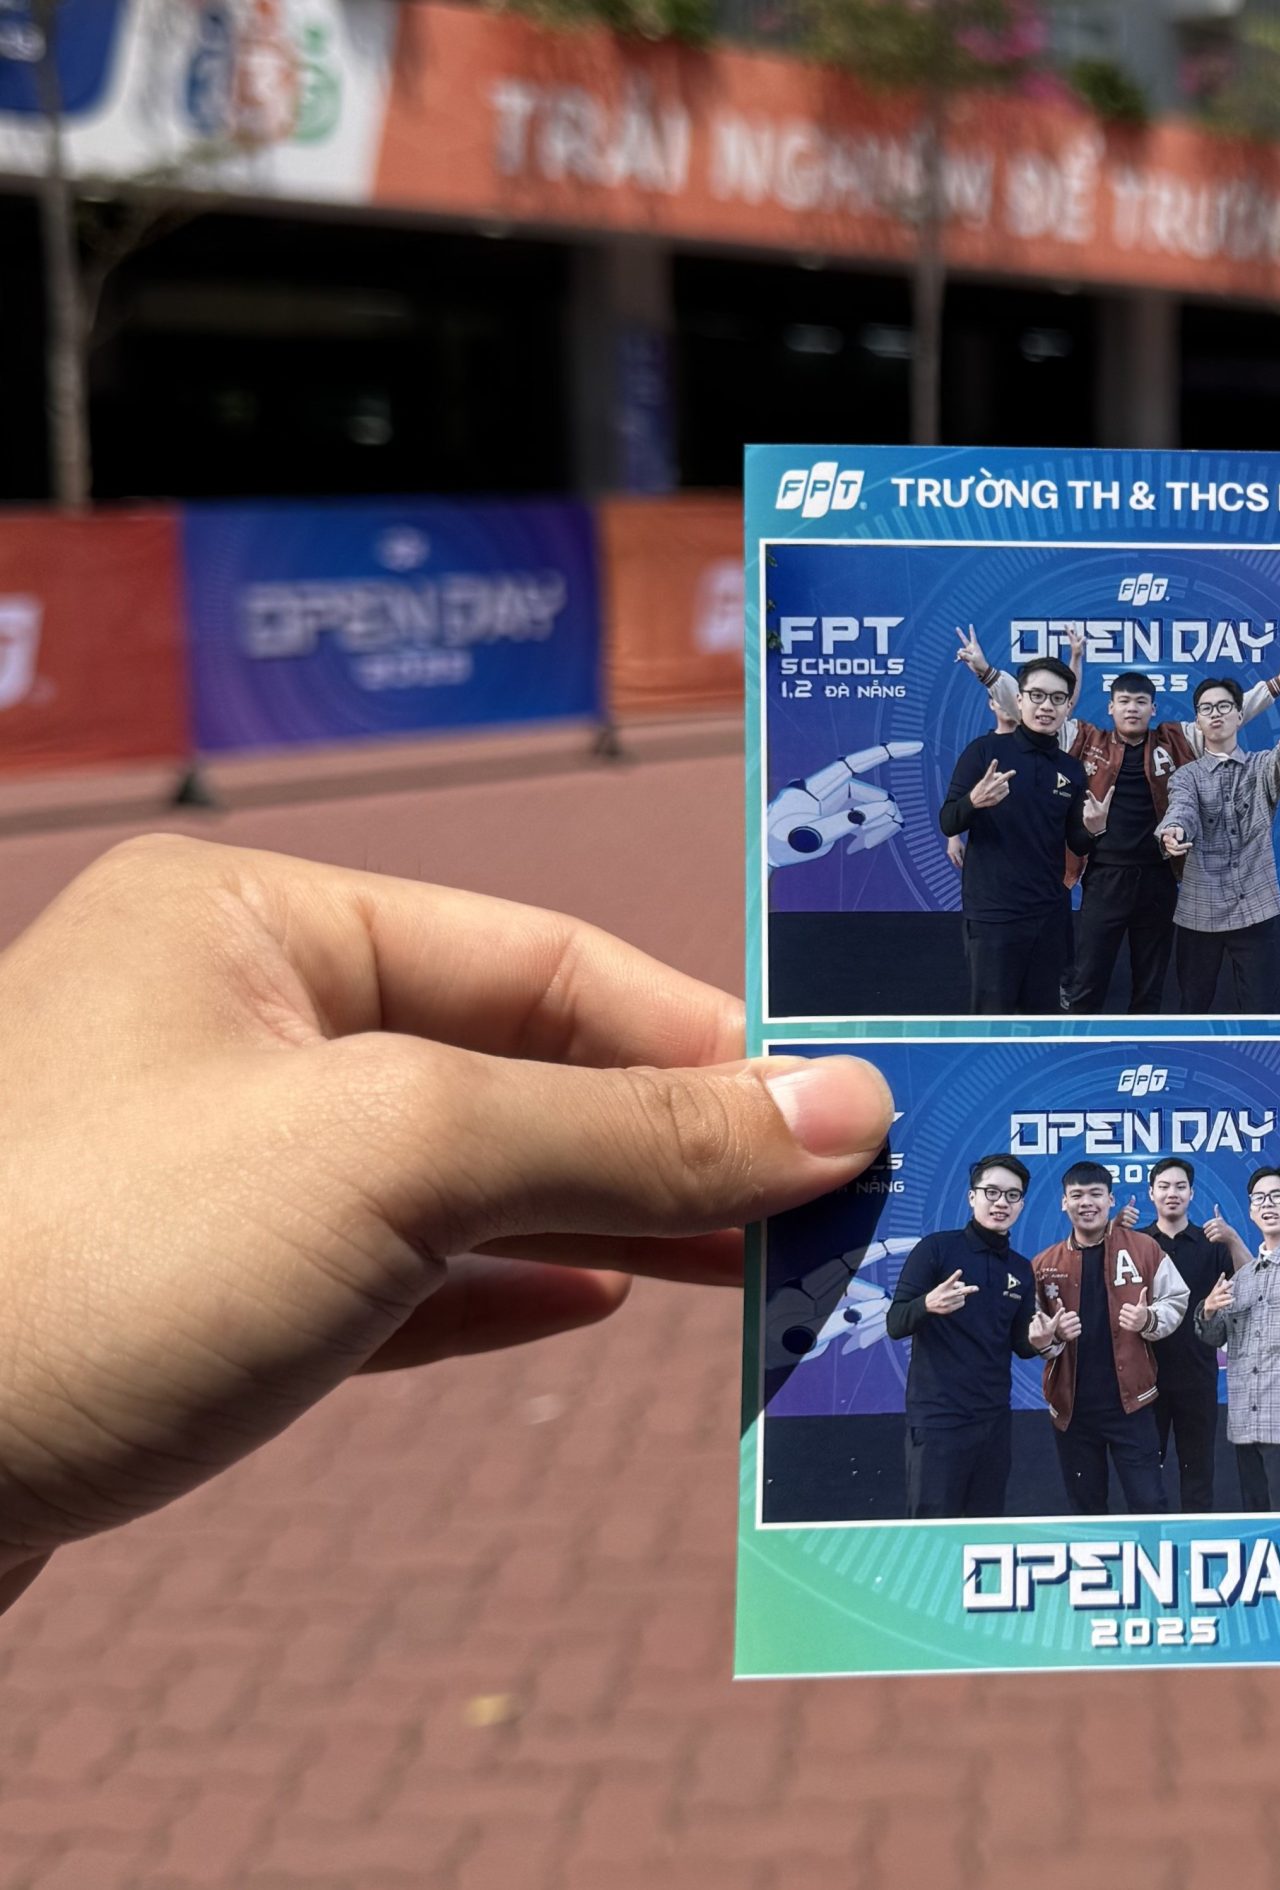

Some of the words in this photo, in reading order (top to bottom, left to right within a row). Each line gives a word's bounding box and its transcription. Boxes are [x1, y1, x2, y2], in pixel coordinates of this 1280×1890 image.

[890, 467, 1058, 509] TRƯỜNG
[1067, 480, 1120, 510] TH
[1129, 481, 1156, 511] &
[1166, 482, 1269, 512] THCS
[780, 616, 905, 655] FPT
[1010, 620, 1160, 663] OPEN
[1172, 621, 1275, 663] DAY
[781, 658, 905, 675] SCHOOLS
[1101, 673, 1189, 692] 225
[824, 682, 850, 699] ĐÀ
[857, 680, 906, 699] NẴNG
[1152, 745, 1177, 777] A
[1010, 1112, 1160, 1155] OPEN
[1172, 1111, 1275, 1153] DAY
[1113, 1248, 1143, 1287] A
[963, 1540, 1174, 1609] OPEN
[1091, 1615, 1219, 1648] 2025
